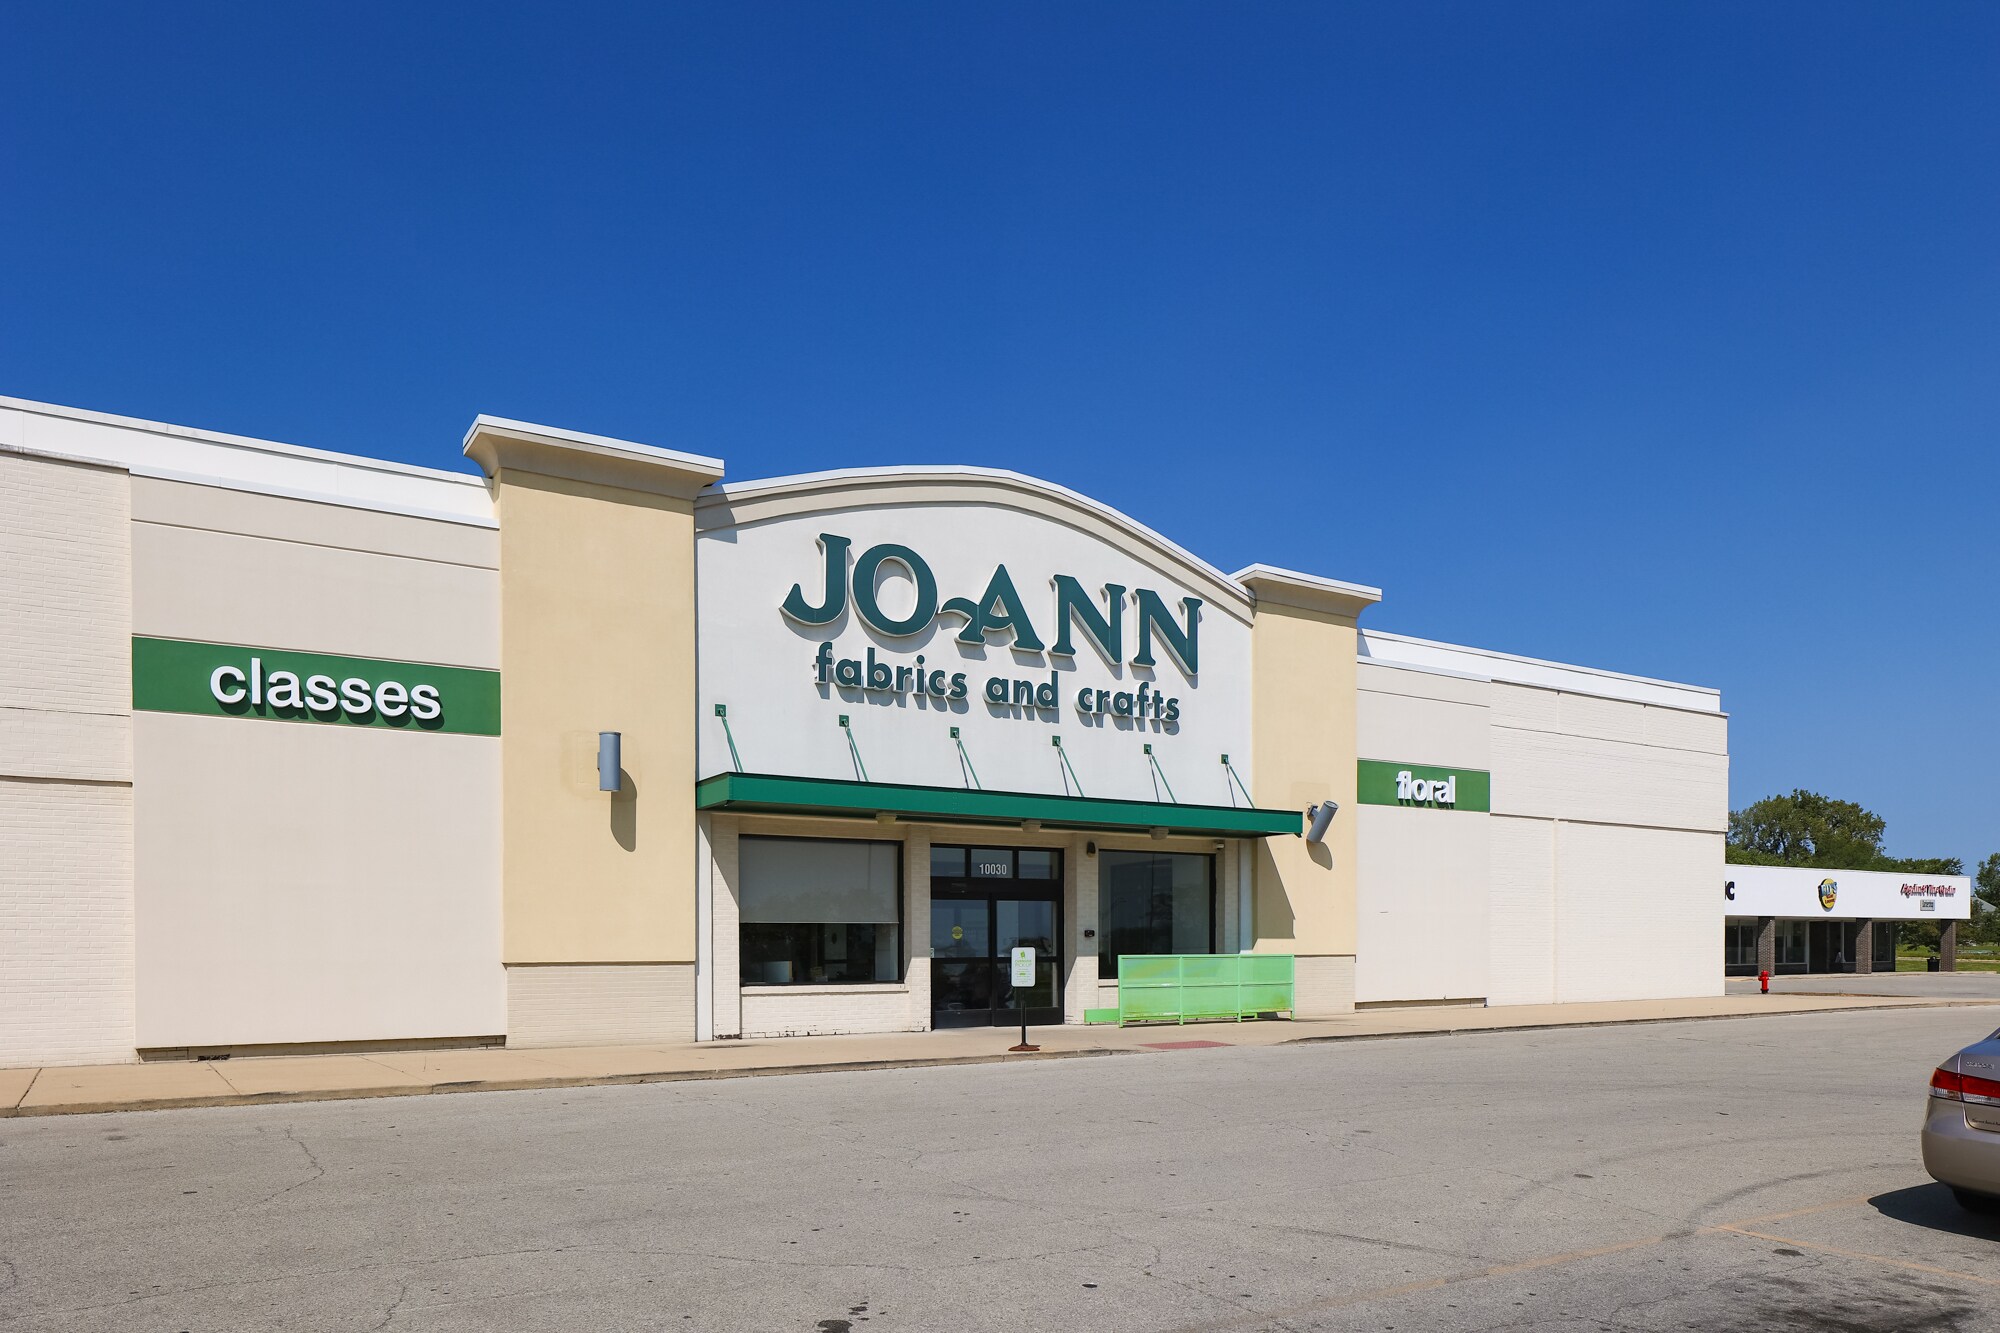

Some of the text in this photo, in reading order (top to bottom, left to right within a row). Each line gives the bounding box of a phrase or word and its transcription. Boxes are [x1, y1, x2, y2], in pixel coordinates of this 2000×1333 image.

[209, 657, 442, 720] classes
[814, 642, 1180, 722] fabrics and crafts
[1396, 771, 1456, 803] floral
[979, 863, 1007, 875] 10030
